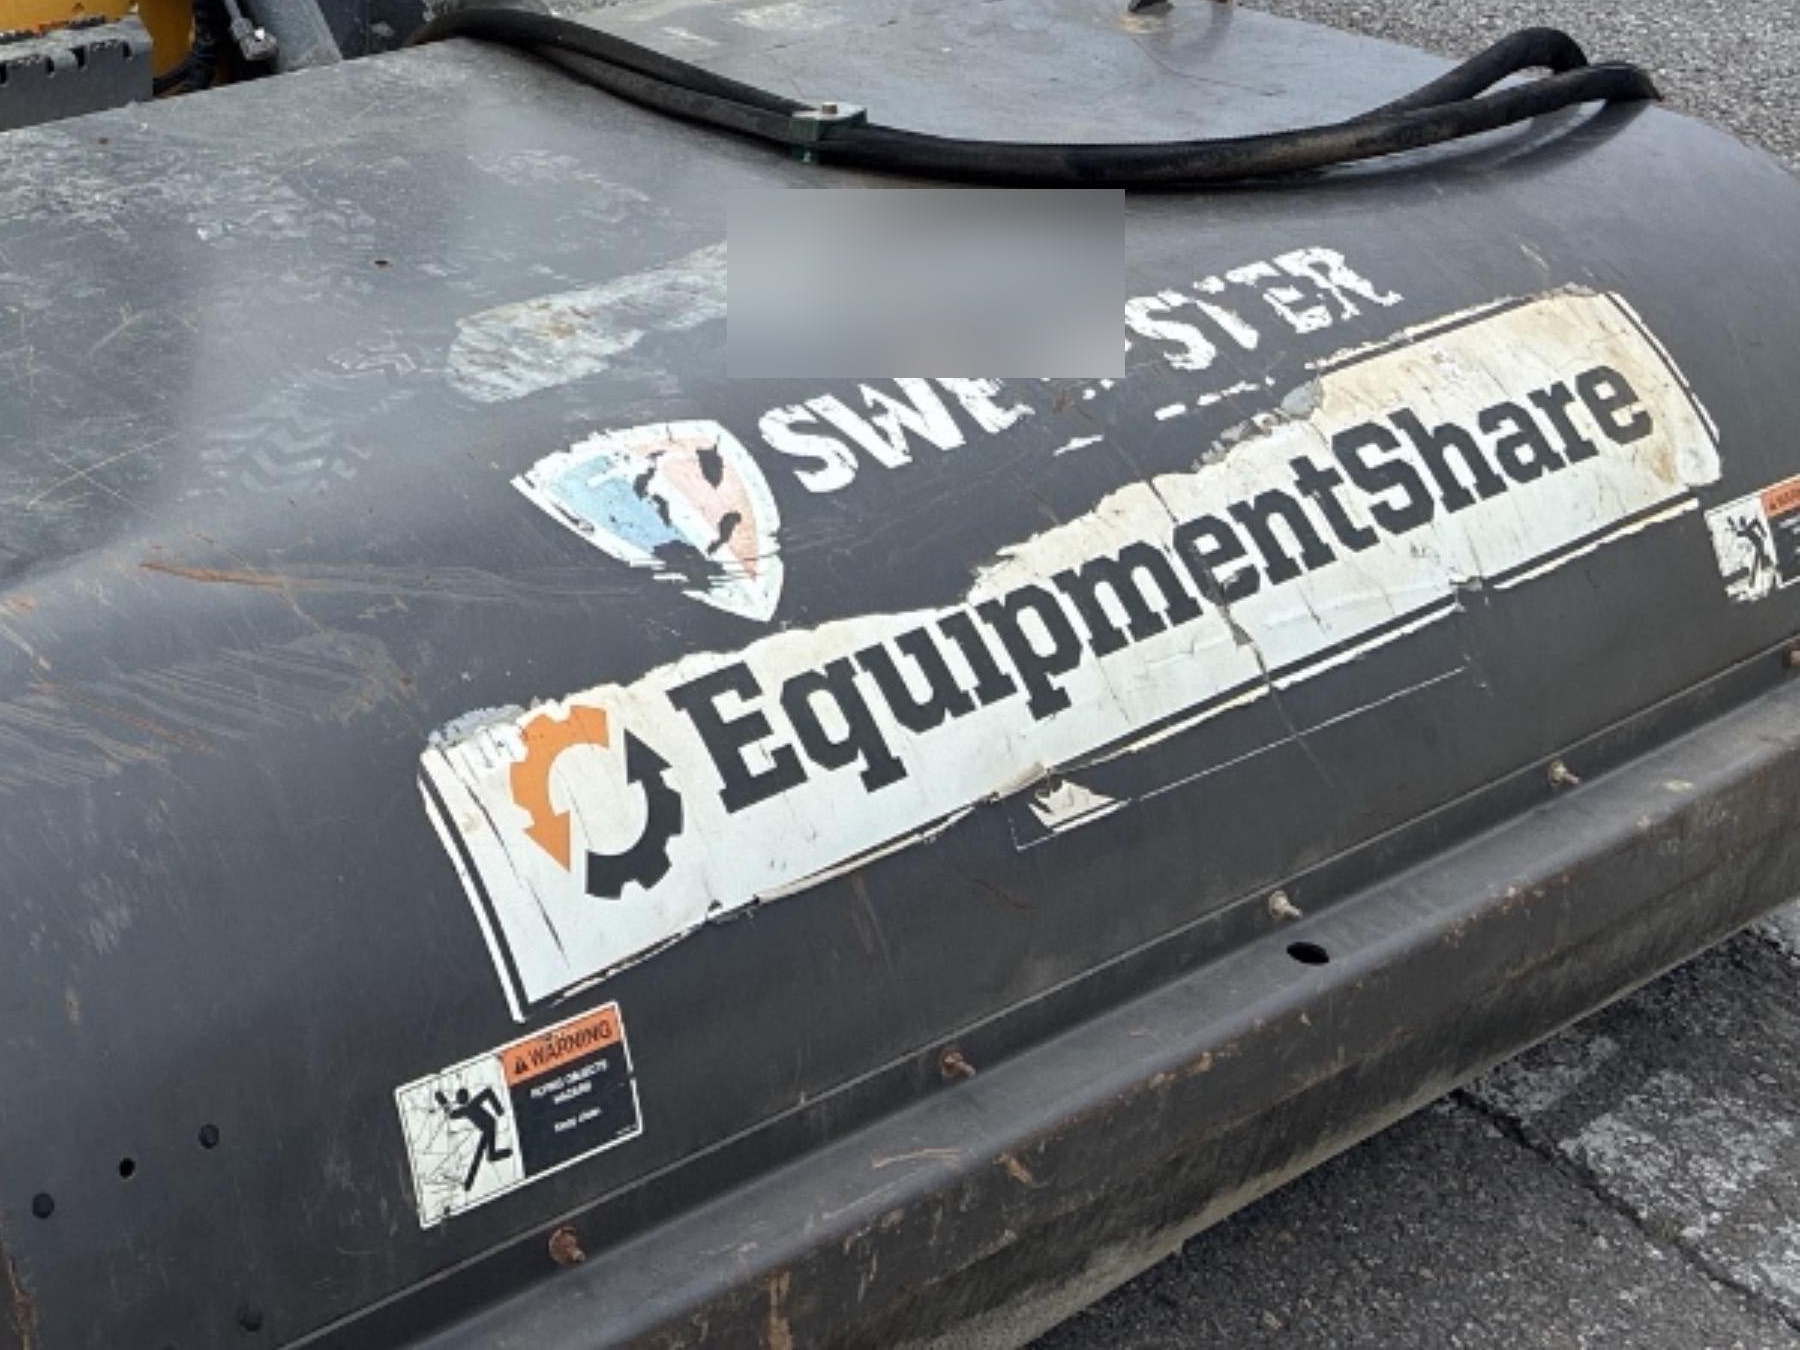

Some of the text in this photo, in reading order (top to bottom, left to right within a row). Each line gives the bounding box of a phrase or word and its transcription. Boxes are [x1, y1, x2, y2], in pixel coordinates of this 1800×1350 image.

[756, 245, 1403, 495] SWESTER
[665, 364, 1653, 814] EquipmentShare
[528, 1020, 613, 1066] WARNING
